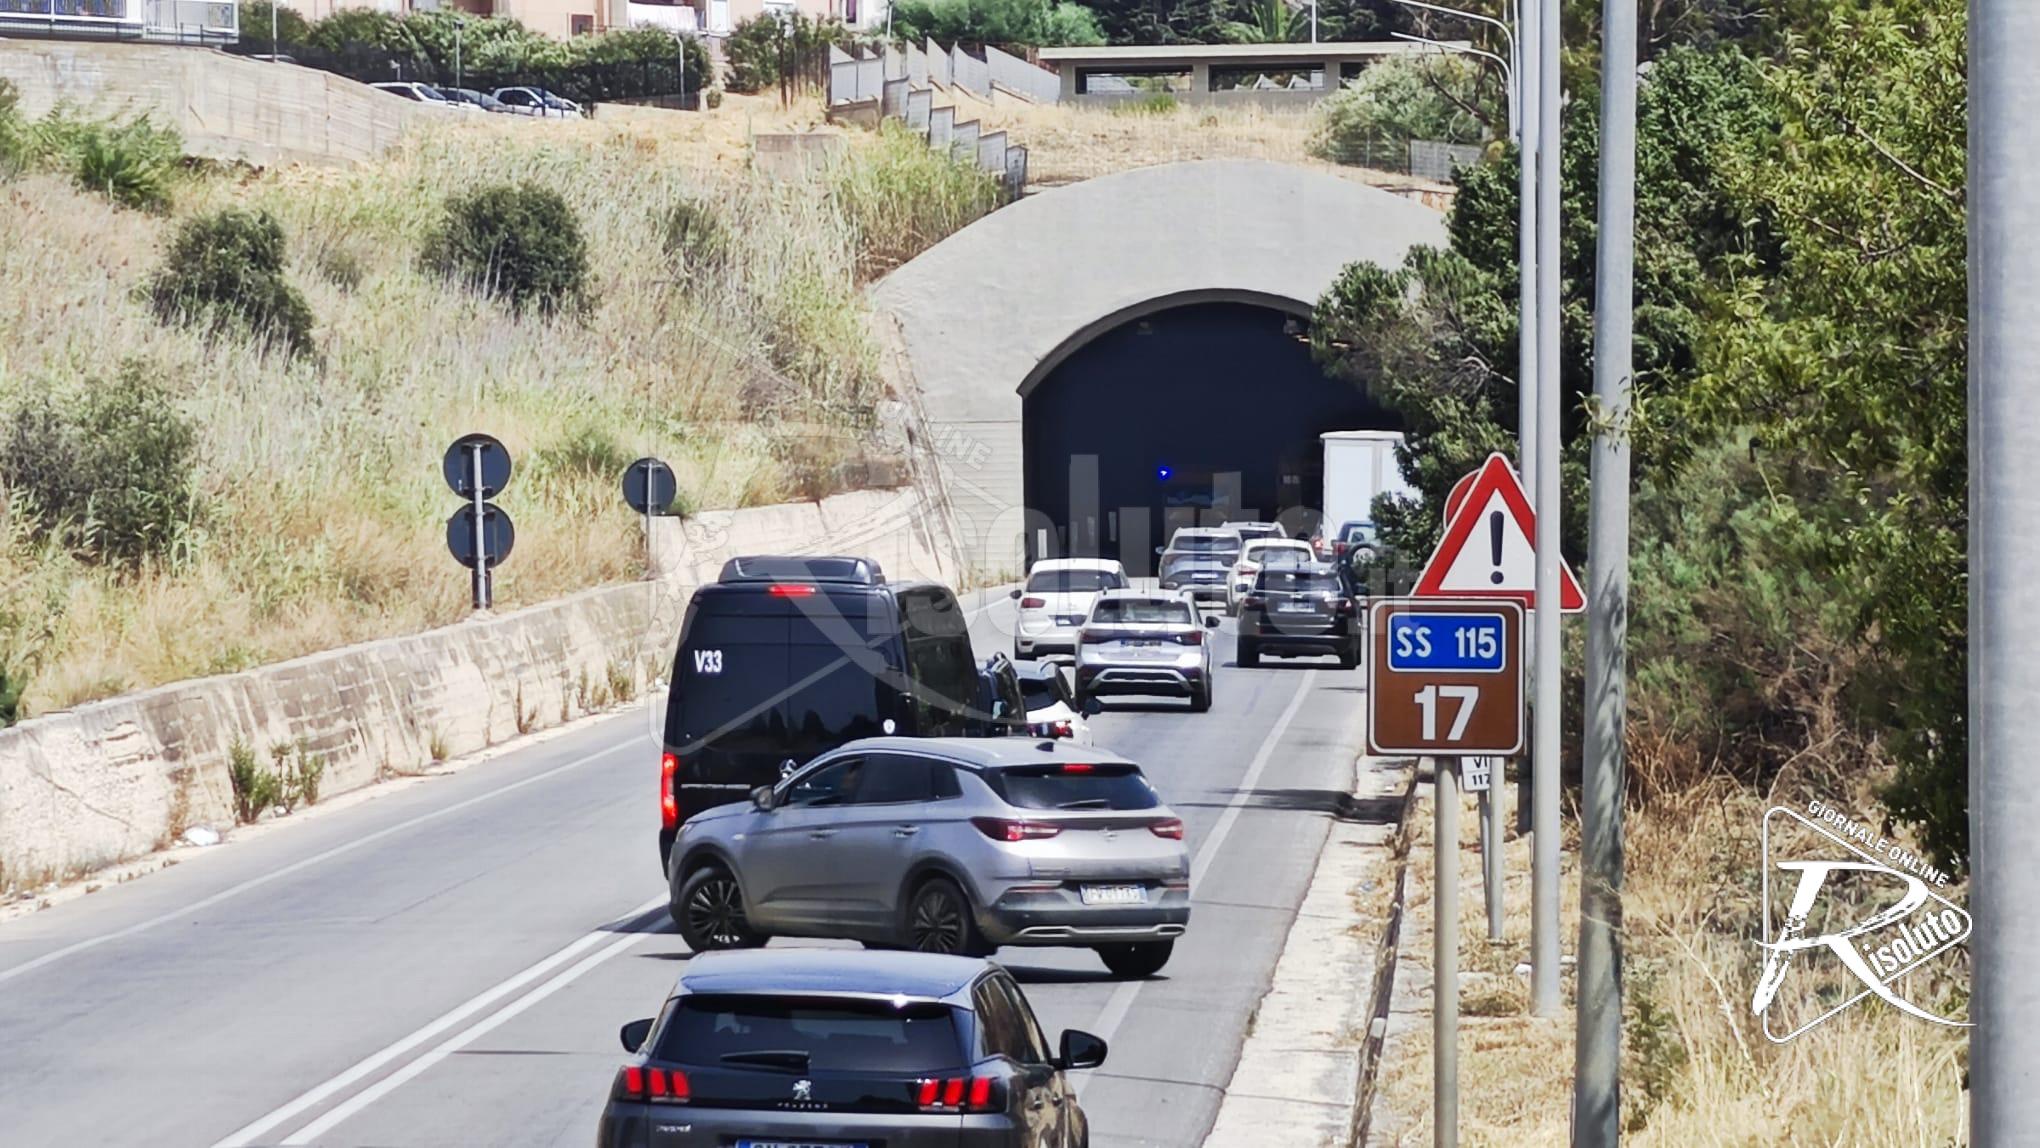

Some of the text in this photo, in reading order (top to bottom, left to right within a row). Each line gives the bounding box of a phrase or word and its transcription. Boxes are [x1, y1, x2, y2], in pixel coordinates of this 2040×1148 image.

[1396, 626, 1497, 659] SS 115
[694, 649, 723, 674] V33
[1414, 685, 1480, 741] 17
